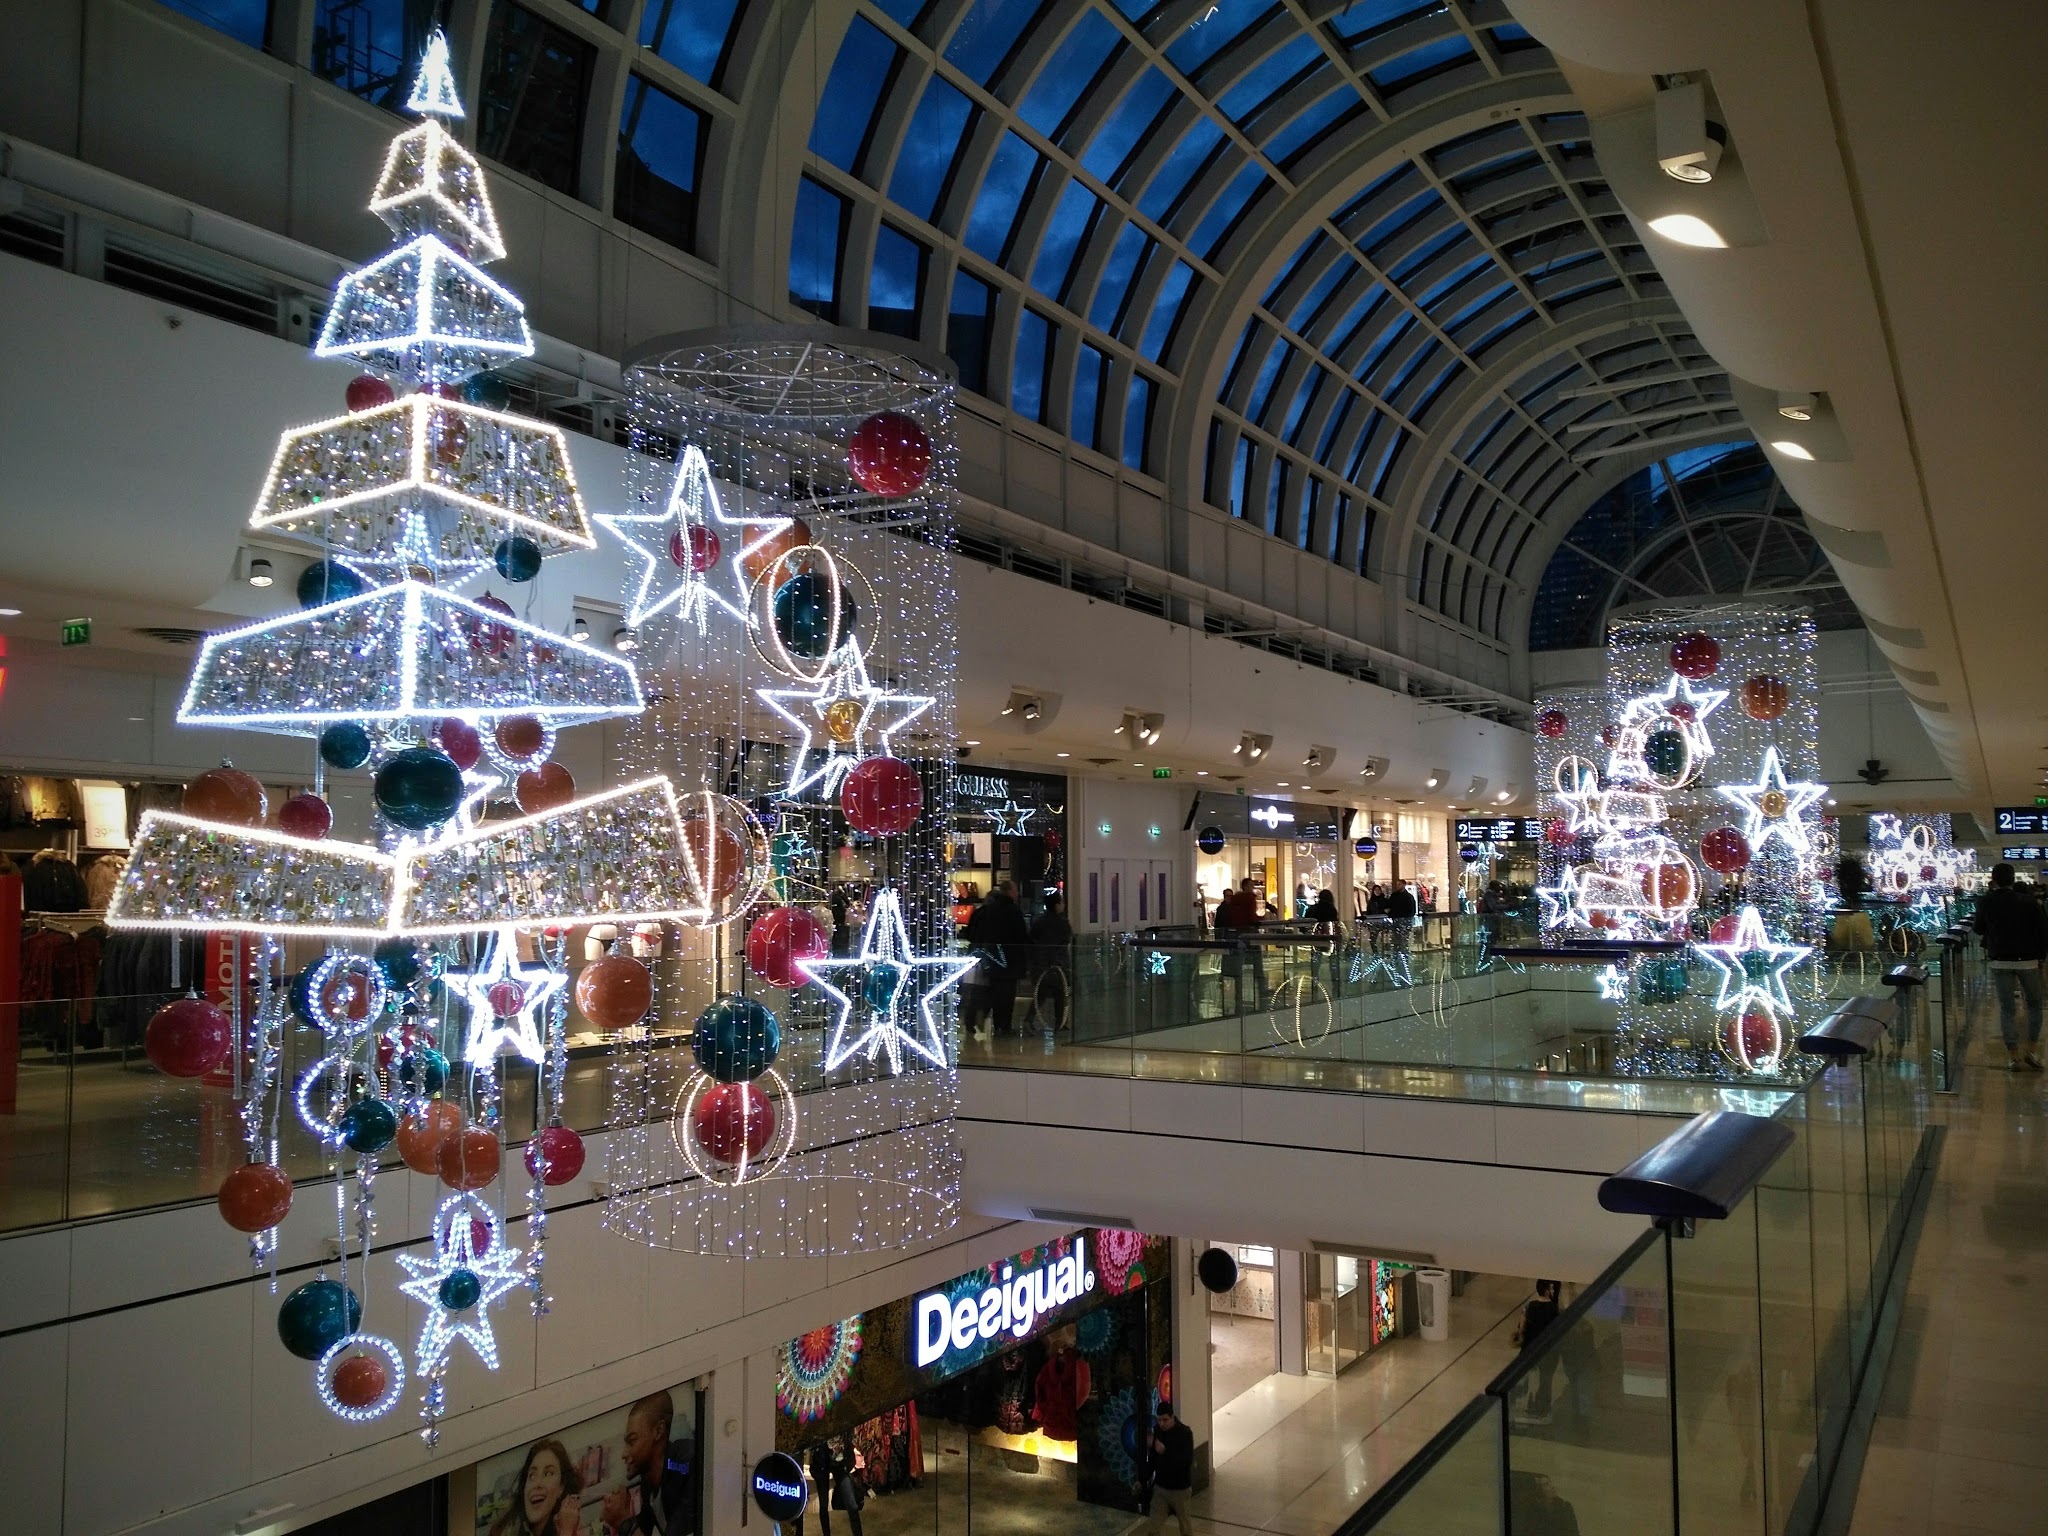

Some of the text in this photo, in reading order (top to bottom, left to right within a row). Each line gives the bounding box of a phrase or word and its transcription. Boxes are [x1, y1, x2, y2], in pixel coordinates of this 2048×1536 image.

[957, 773, 1009, 799] GUESS
[1458, 823, 1468, 838] 2
[1999, 813, 2012, 829] 2
[918, 1236, 1085, 1368] Desigual
[756, 1476, 801, 1498] Desigual
